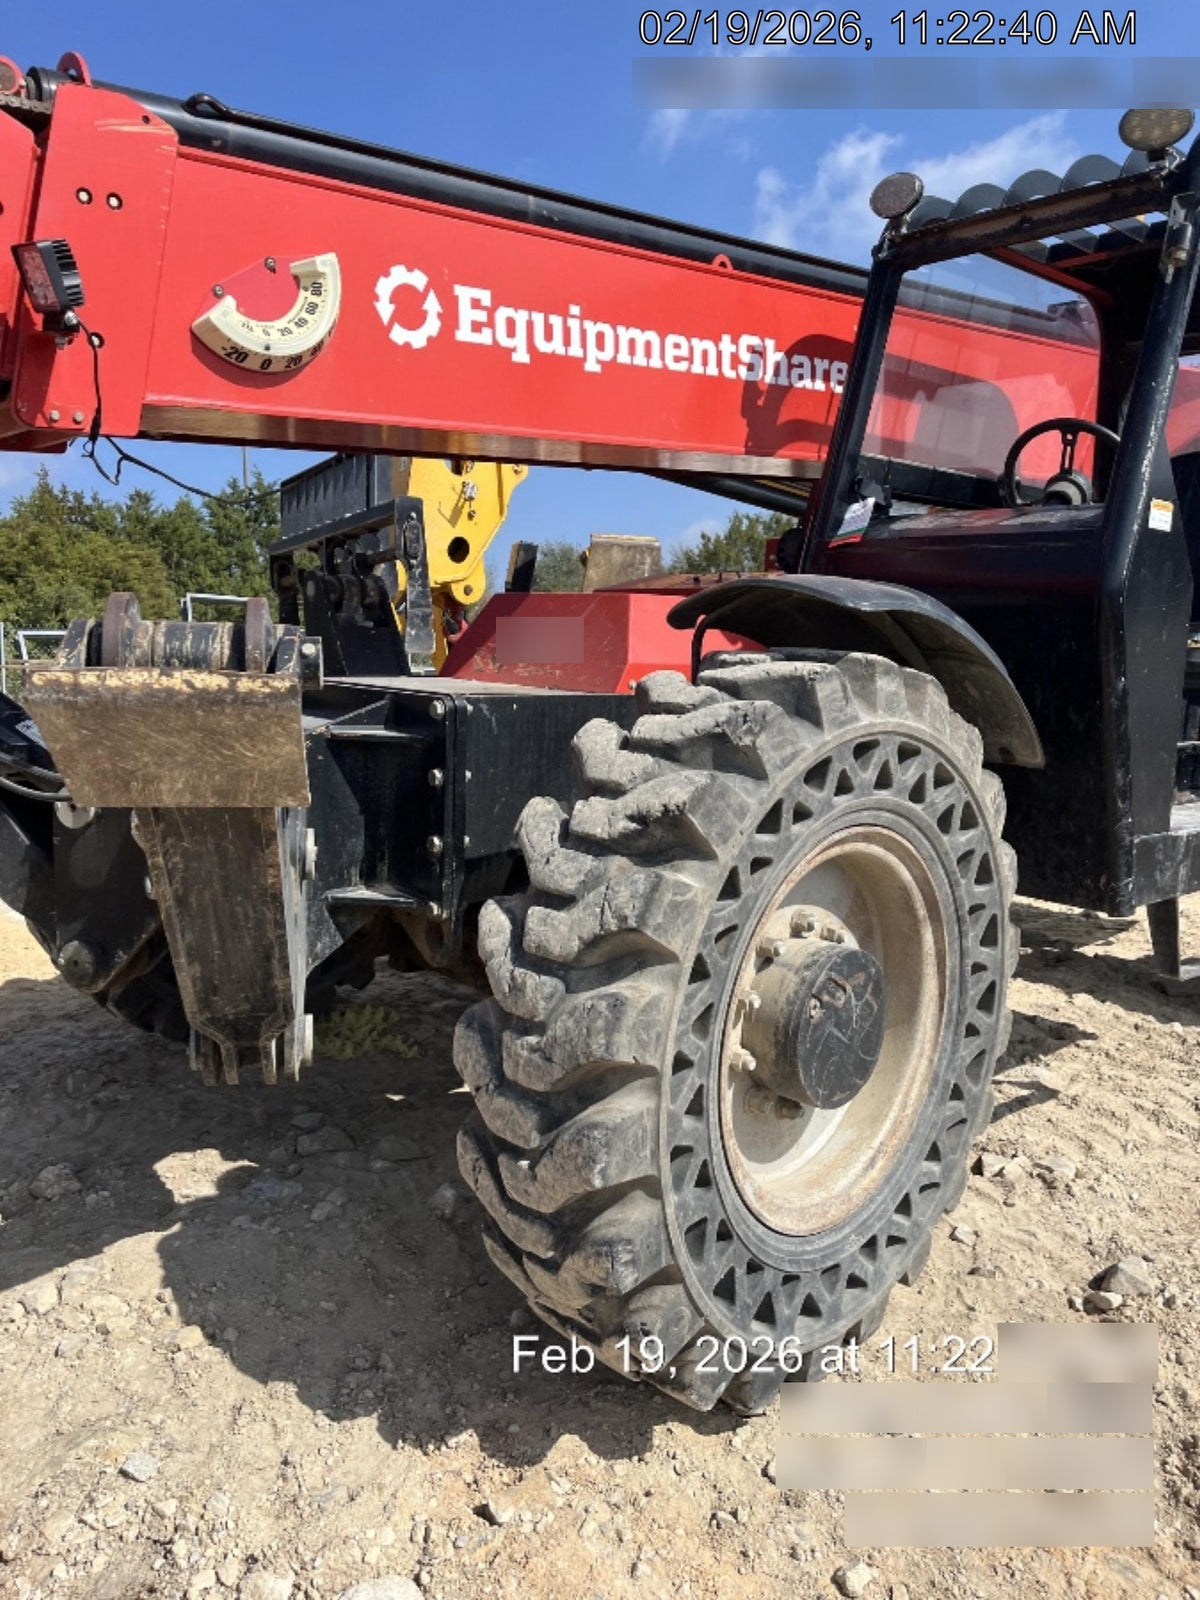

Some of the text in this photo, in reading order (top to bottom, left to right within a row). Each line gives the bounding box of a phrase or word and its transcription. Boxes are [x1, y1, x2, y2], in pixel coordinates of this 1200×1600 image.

[311, 282, 322, 296] 80
[453, 284, 848, 393] EquipmentShare
[221, 346, 249, 363] -20
[285, 355, 302, 368] 20
[260, 358, 272, 370] 0
